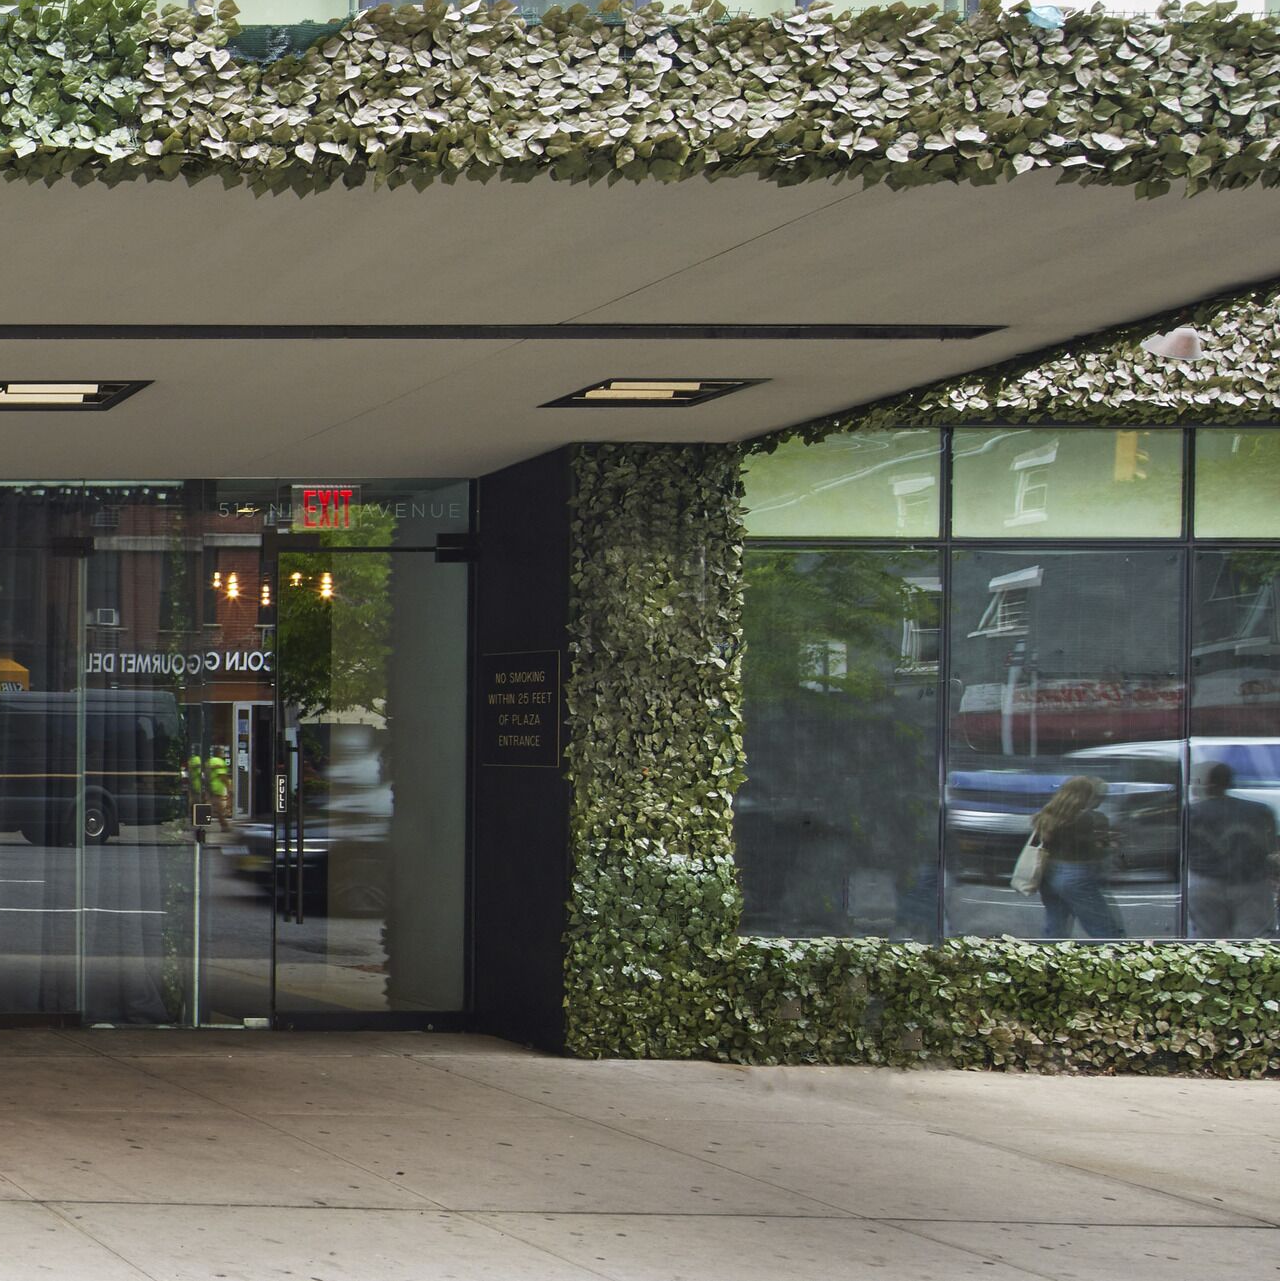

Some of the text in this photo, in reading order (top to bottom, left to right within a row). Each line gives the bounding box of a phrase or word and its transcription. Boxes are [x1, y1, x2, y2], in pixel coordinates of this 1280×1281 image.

[218, 503, 255, 518] 515
[359, 503, 461, 518] AVENUE
[303, 489, 353, 529] EXIT
[495, 671, 545, 684] NO SMOKING
[488, 692, 553, 705] WITHIN 25 FEET
[498, 714, 541, 726] OF PLAZA
[499, 735, 541, 747] ENTRANCE
